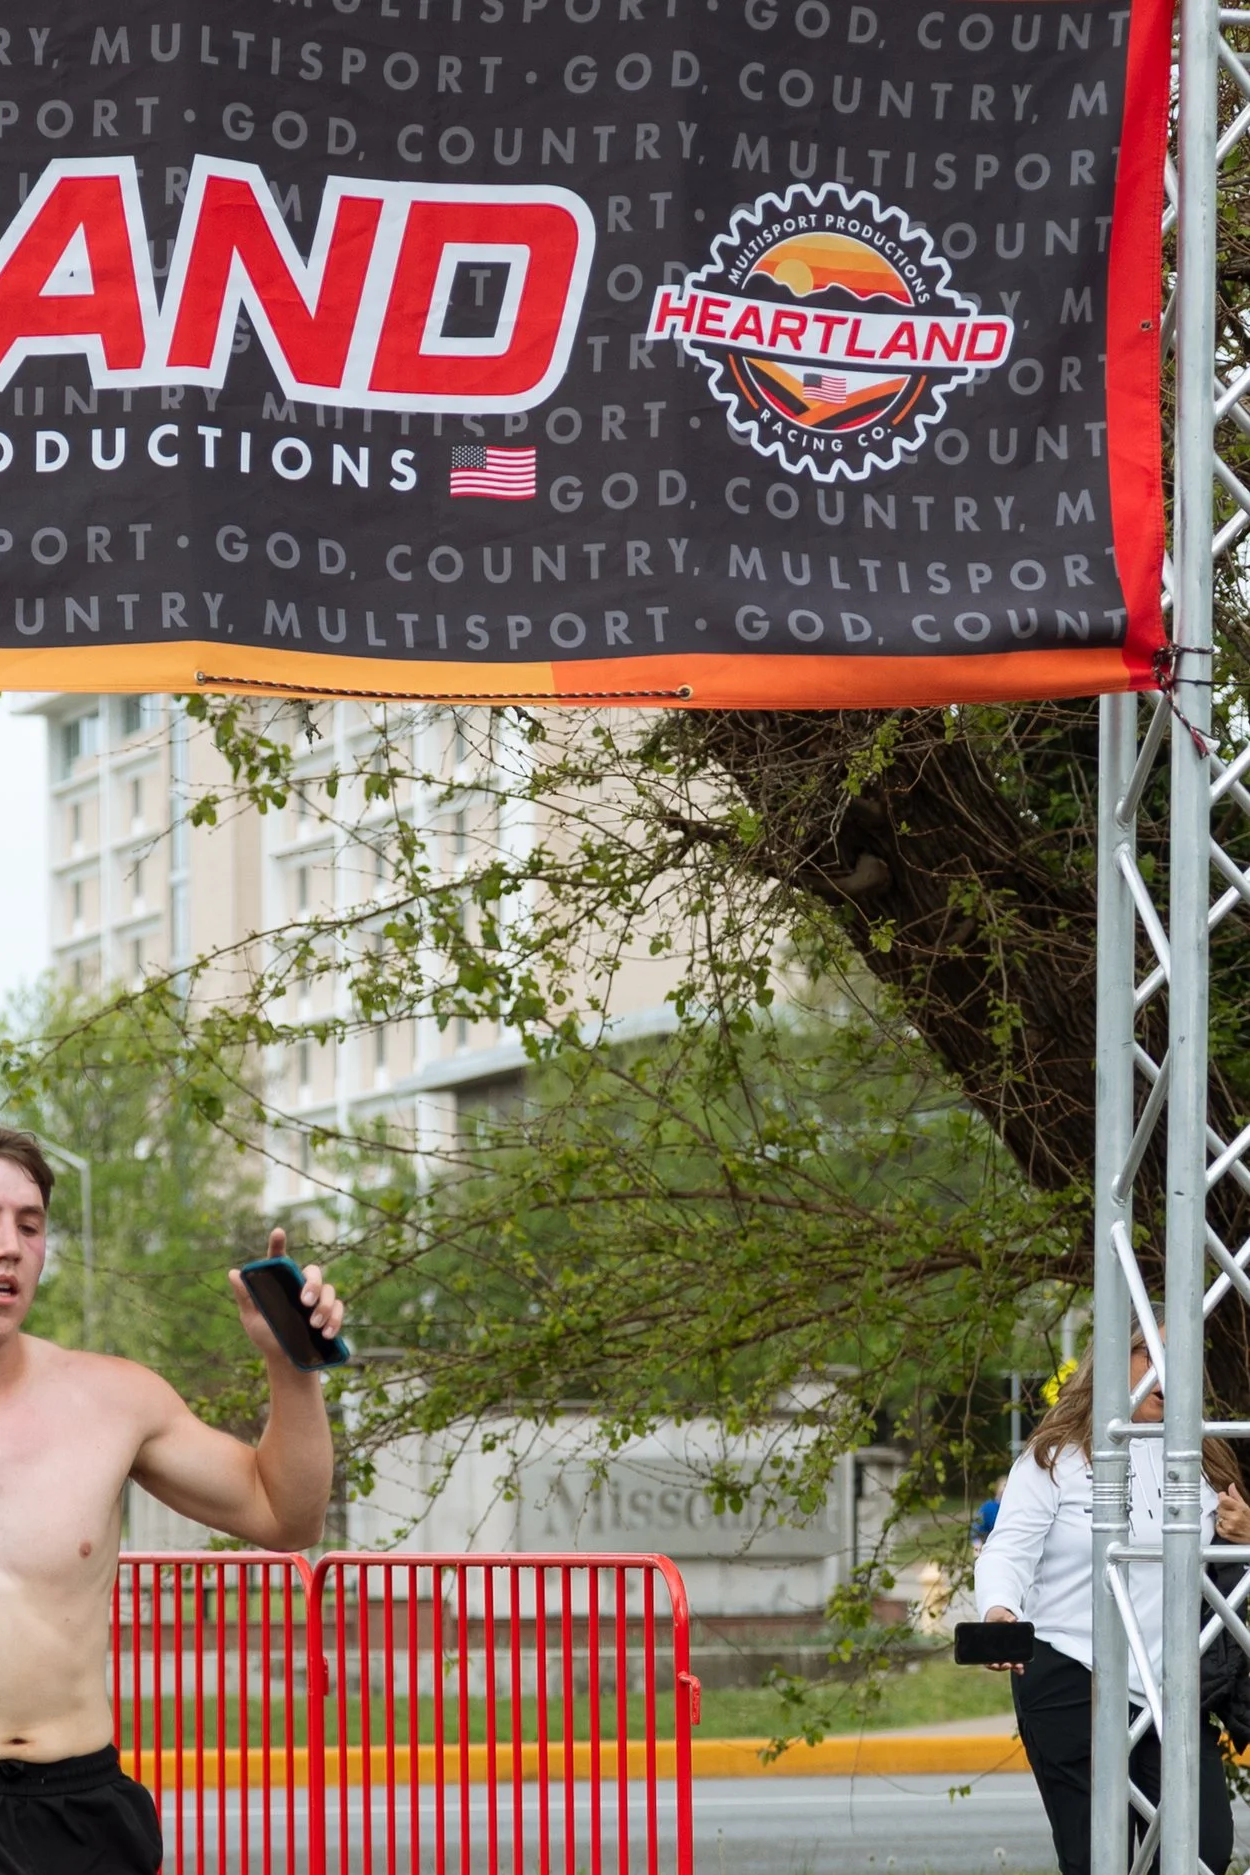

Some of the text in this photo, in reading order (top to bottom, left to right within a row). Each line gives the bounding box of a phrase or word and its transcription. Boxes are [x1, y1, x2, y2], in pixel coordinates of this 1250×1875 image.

[917, 10, 1130, 52] COUNT
[90, 23, 503, 94] MULTISPORT
[563, 50, 709, 95] GOD,
[738, 62, 1040, 125] COUNTRY,
[1066, 80, 1109, 120] M
[222, 102, 365, 162] GOD,
[397, 121, 706, 166] COUNTRY,
[731, 132, 1120, 191] MULTISPOR
[728, 213, 817, 285] MULTISPORT
[824, 213, 930, 305] PRODUCTIONS
[912, 216, 1111, 259] OUNT
[650, 289, 1012, 365] HEARTLAND
[760, 408, 892, 452] RACING CO.
[904, 421, 1107, 465] OUNT
[550, 469, 697, 513] GOD,
[725, 477, 1026, 532] COUNTRY,
[216, 524, 356, 580] GOD,
[385, 537, 700, 584] COUNTRY,
[263, 599, 669, 651] MULTISPORT
[735, 604, 884, 646] GOD,
[911, 607, 1127, 642] COUNT
